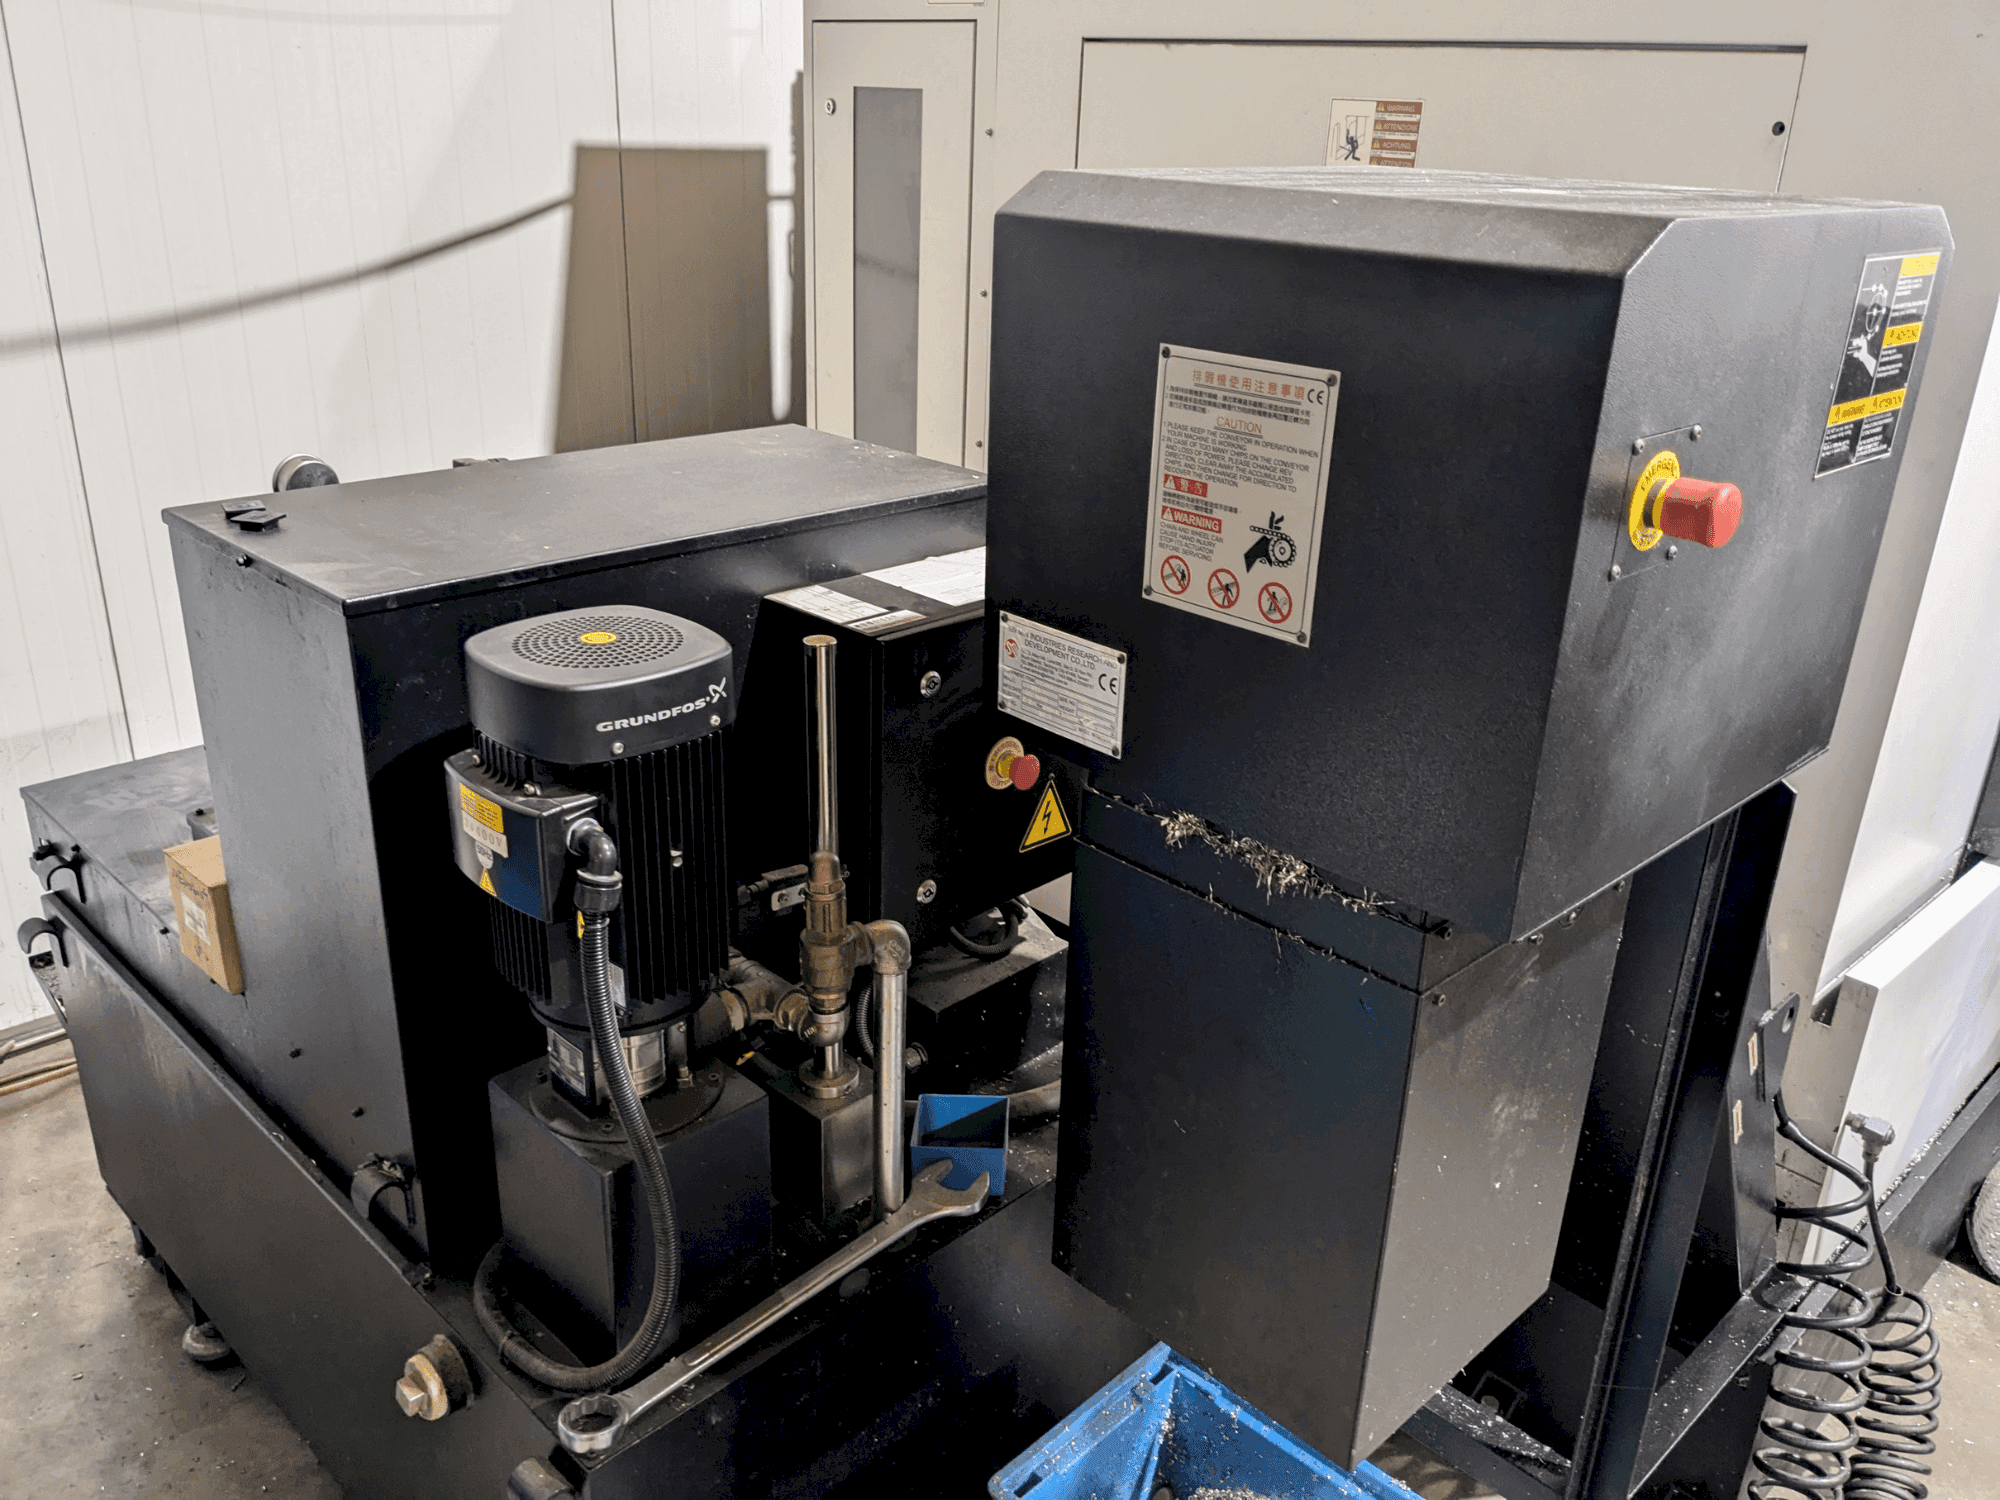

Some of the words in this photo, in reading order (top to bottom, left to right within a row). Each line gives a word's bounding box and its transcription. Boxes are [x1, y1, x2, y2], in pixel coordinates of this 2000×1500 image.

[1216, 416, 1262, 433] CAUTION
[1167, 429, 1182, 437] YOUR
[1184, 432, 1209, 443] MACHINE
[1190, 426, 1204, 434] KEEP
[1218, 432, 1252, 444] CONVEYOR
[1261, 441, 1297, 453] OPERATION
[1299, 448, 1318, 457] WHEN
[1166, 443, 1176, 451] AND
[1178, 446, 1193, 454] LOSS
[1228, 456, 1250, 466] PLEASE
[1252, 461, 1277, 472] CHANGE
[1173, 437, 1188, 446] CASE
[1212, 446, 1228, 454] MANY
[1229, 449, 1247, 458] CHIPS
[1260, 455, 1271, 463] THE
[1273, 458, 1309, 471] CONVEYOR
[1164, 465, 1190, 476] RECOVER
[1192, 471, 1202, 479] THE
[1184, 462, 1195, 470] AND
[1197, 465, 1212, 473] THEN
[1213, 468, 1237, 479] CHANGE
[1239, 474, 1251, 482] FOR
[1253, 477, 1286, 490] DIRECTION
[1197, 458, 1216, 467] CLEAR
[1218, 462, 1233, 471] AWAY
[1248, 468, 1293, 484] ACCUMULATED
[1160, 521, 1176, 530] CHAIN
[1178, 526, 1189, 534] AND
[1190, 529, 1209, 539] WHEEL
[1211, 534, 1223, 542] CAN
[1173, 510, 1219, 531] WARNING
[1159, 528, 1177, 538] CAUSE
[1179, 533, 1194, 542] HAND
[1159, 535, 1173, 544] STOP
[1184, 541, 1213, 554] ACTUATOR
[1158, 542, 1180, 553] BEFORE
[1024, 638, 1068, 661] DEVELOPMENT
[1030, 632, 1066, 651] INDUSTRIES
[1067, 645, 1102, 664] RESEARCH
[596, 698, 707, 732] GRUNDFOS
